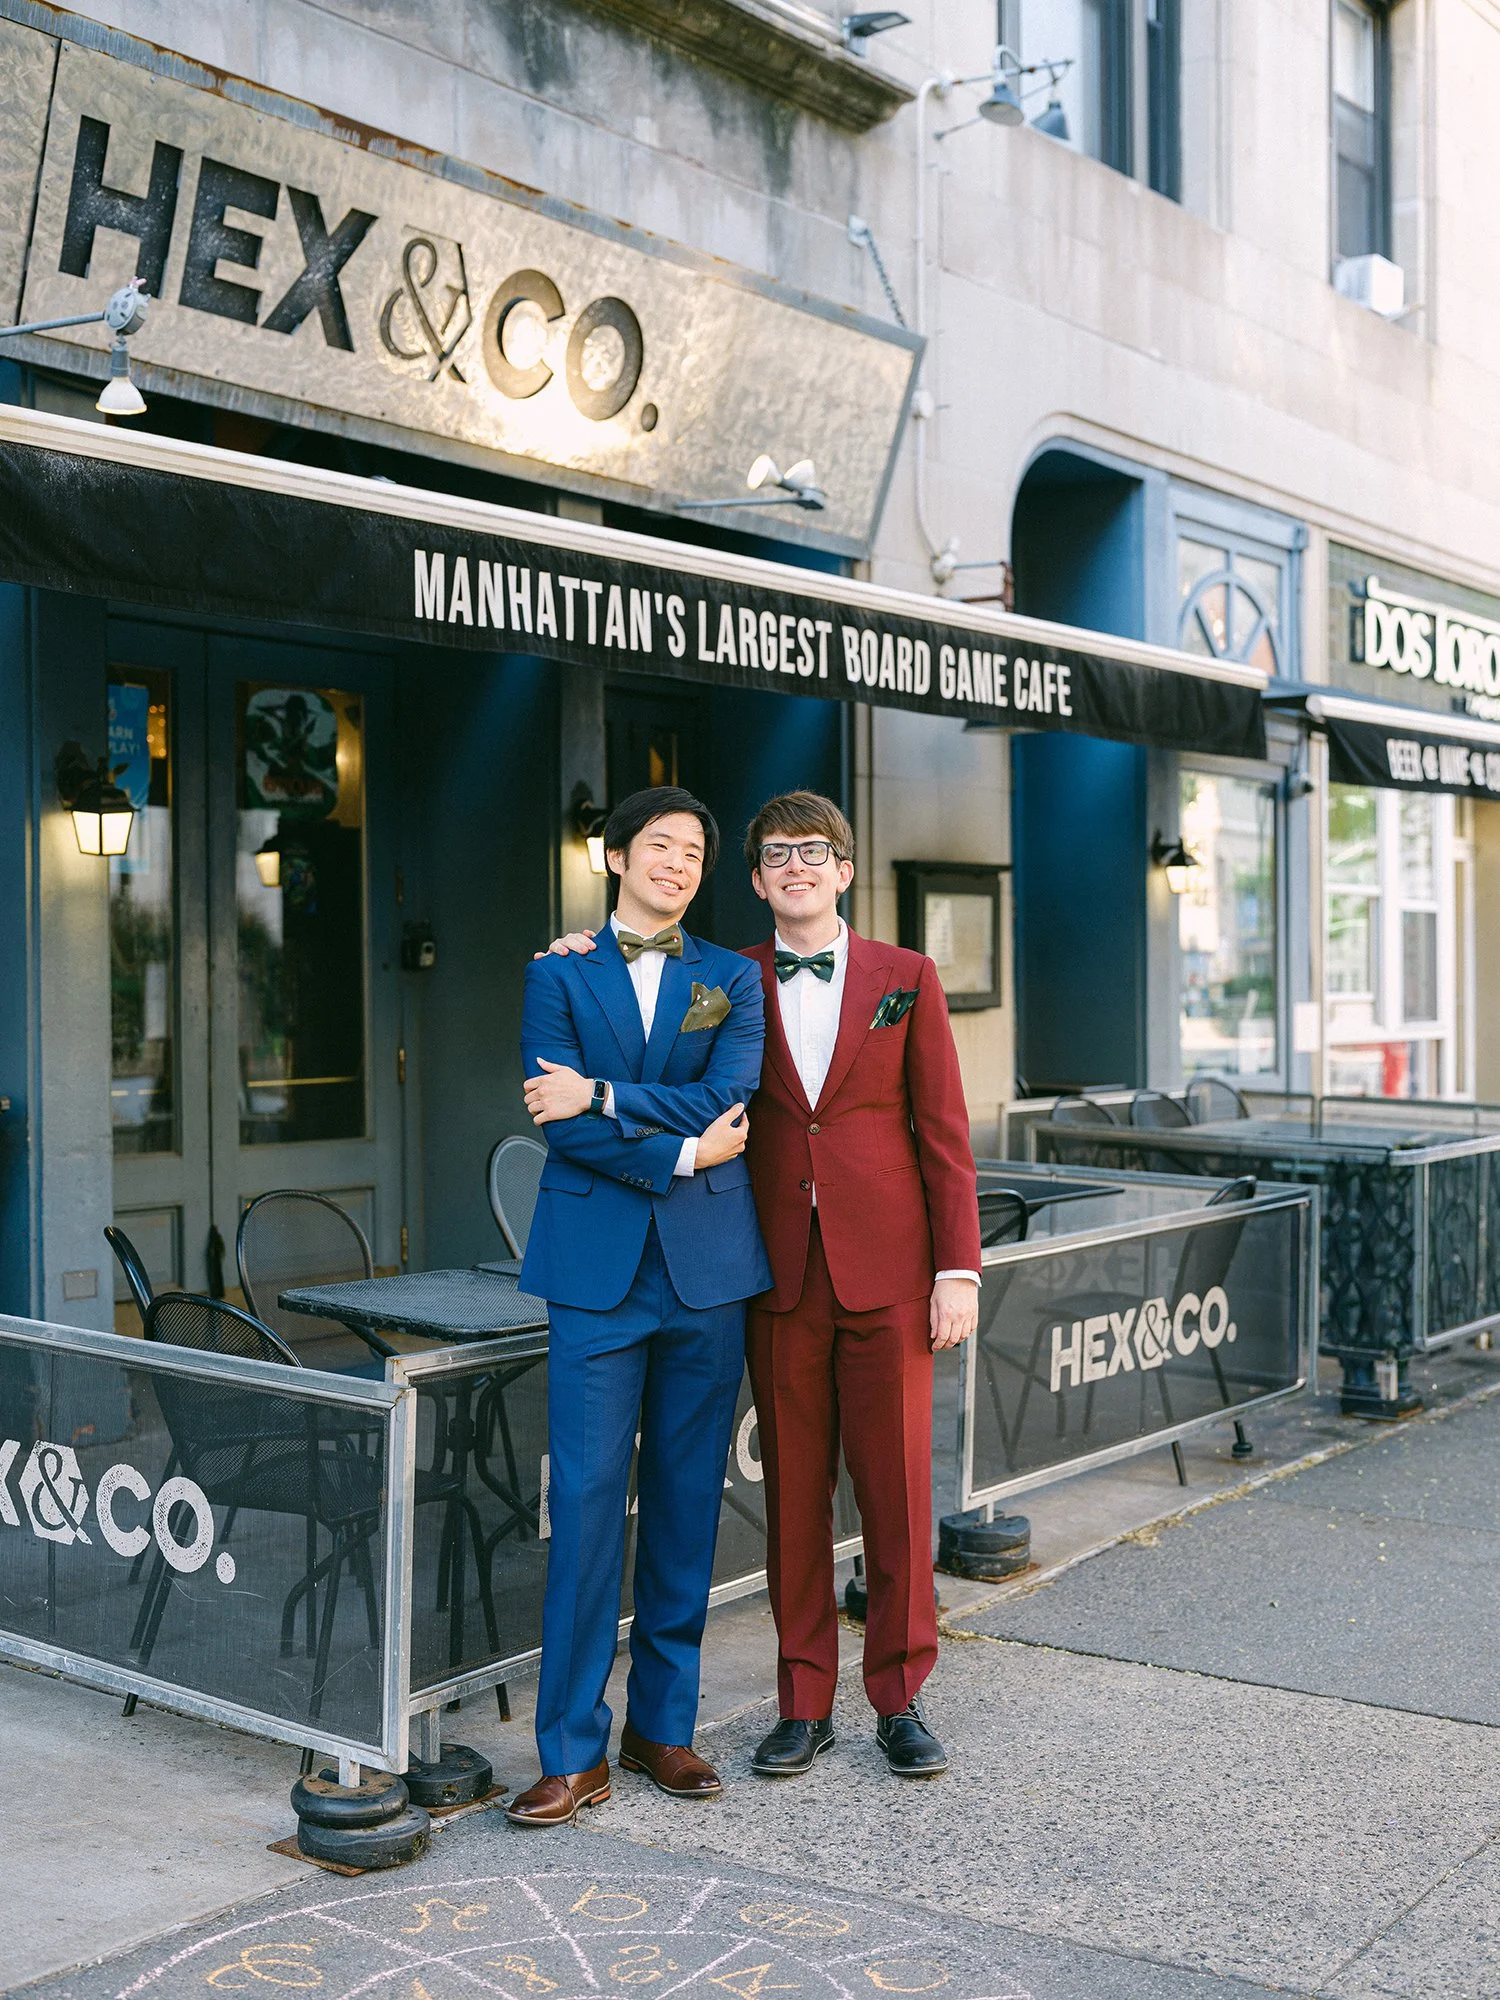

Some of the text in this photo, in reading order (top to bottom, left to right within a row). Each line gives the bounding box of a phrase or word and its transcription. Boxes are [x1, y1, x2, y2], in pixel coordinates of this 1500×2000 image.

[413, 549, 1073, 717] MANHATTAN'S LARGEST BOARD GAME CAFE
[1365, 598, 1433, 679] DOS
[107, 725, 133, 740] ARN
